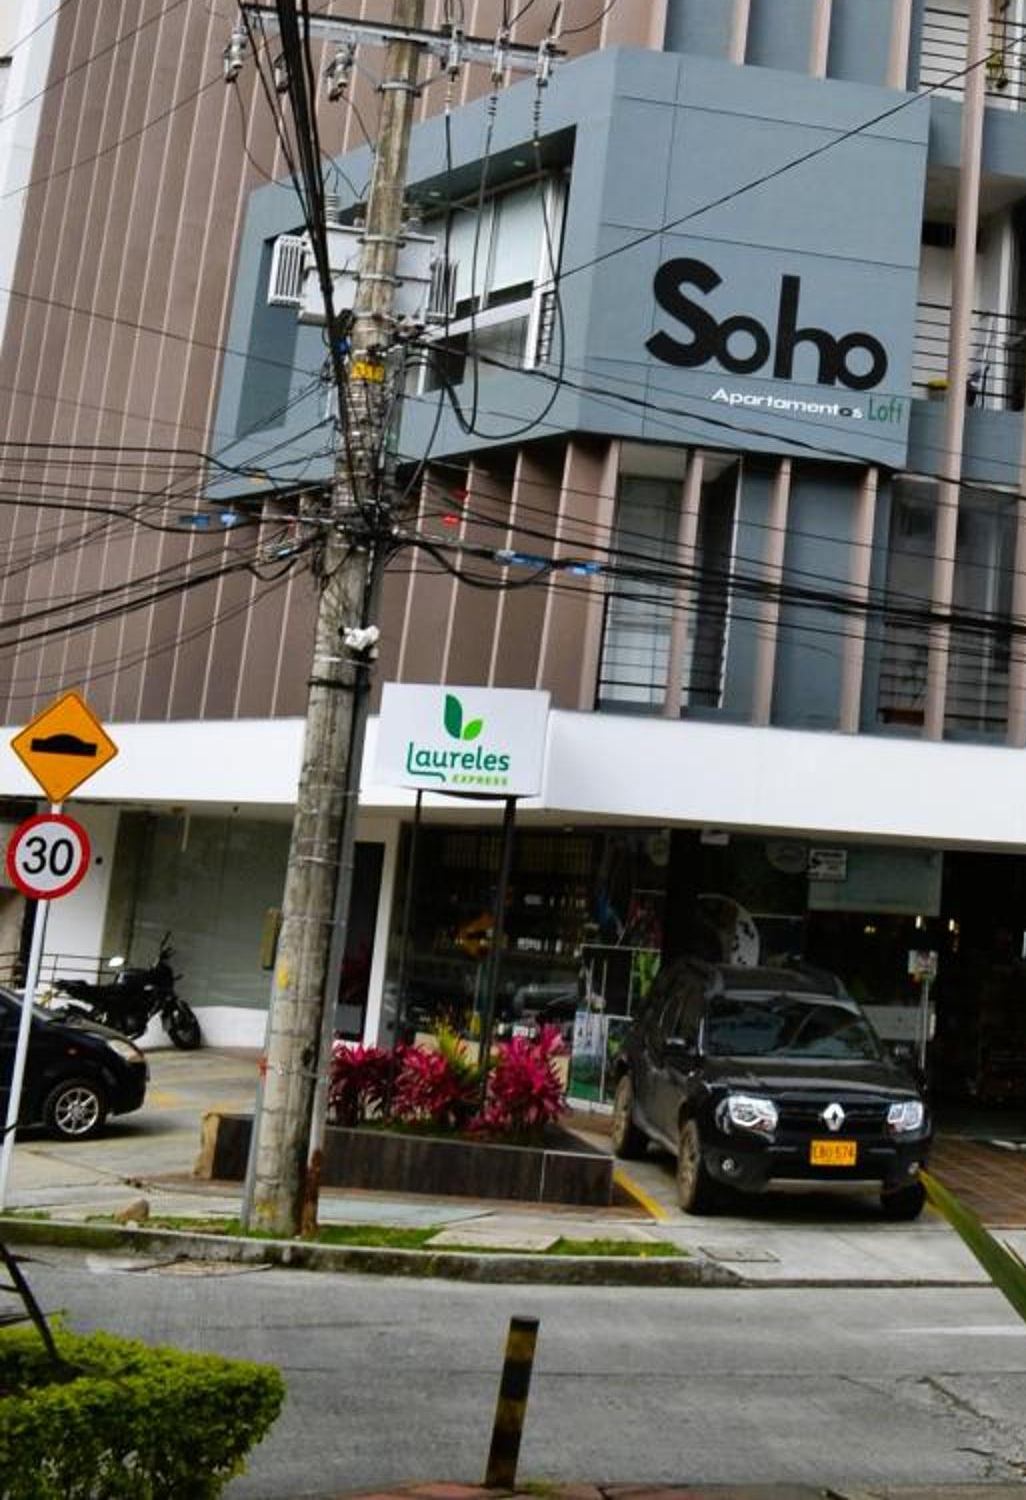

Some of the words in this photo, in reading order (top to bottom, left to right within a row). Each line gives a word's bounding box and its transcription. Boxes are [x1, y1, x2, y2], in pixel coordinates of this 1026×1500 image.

[645, 257, 888, 390] Soho
[711, 387, 863, 420] Apartamentos
[406, 741, 510, 782] Laureles
[452, 773, 508, 786] EXPRESS
[22, 836, 74, 877] 30
